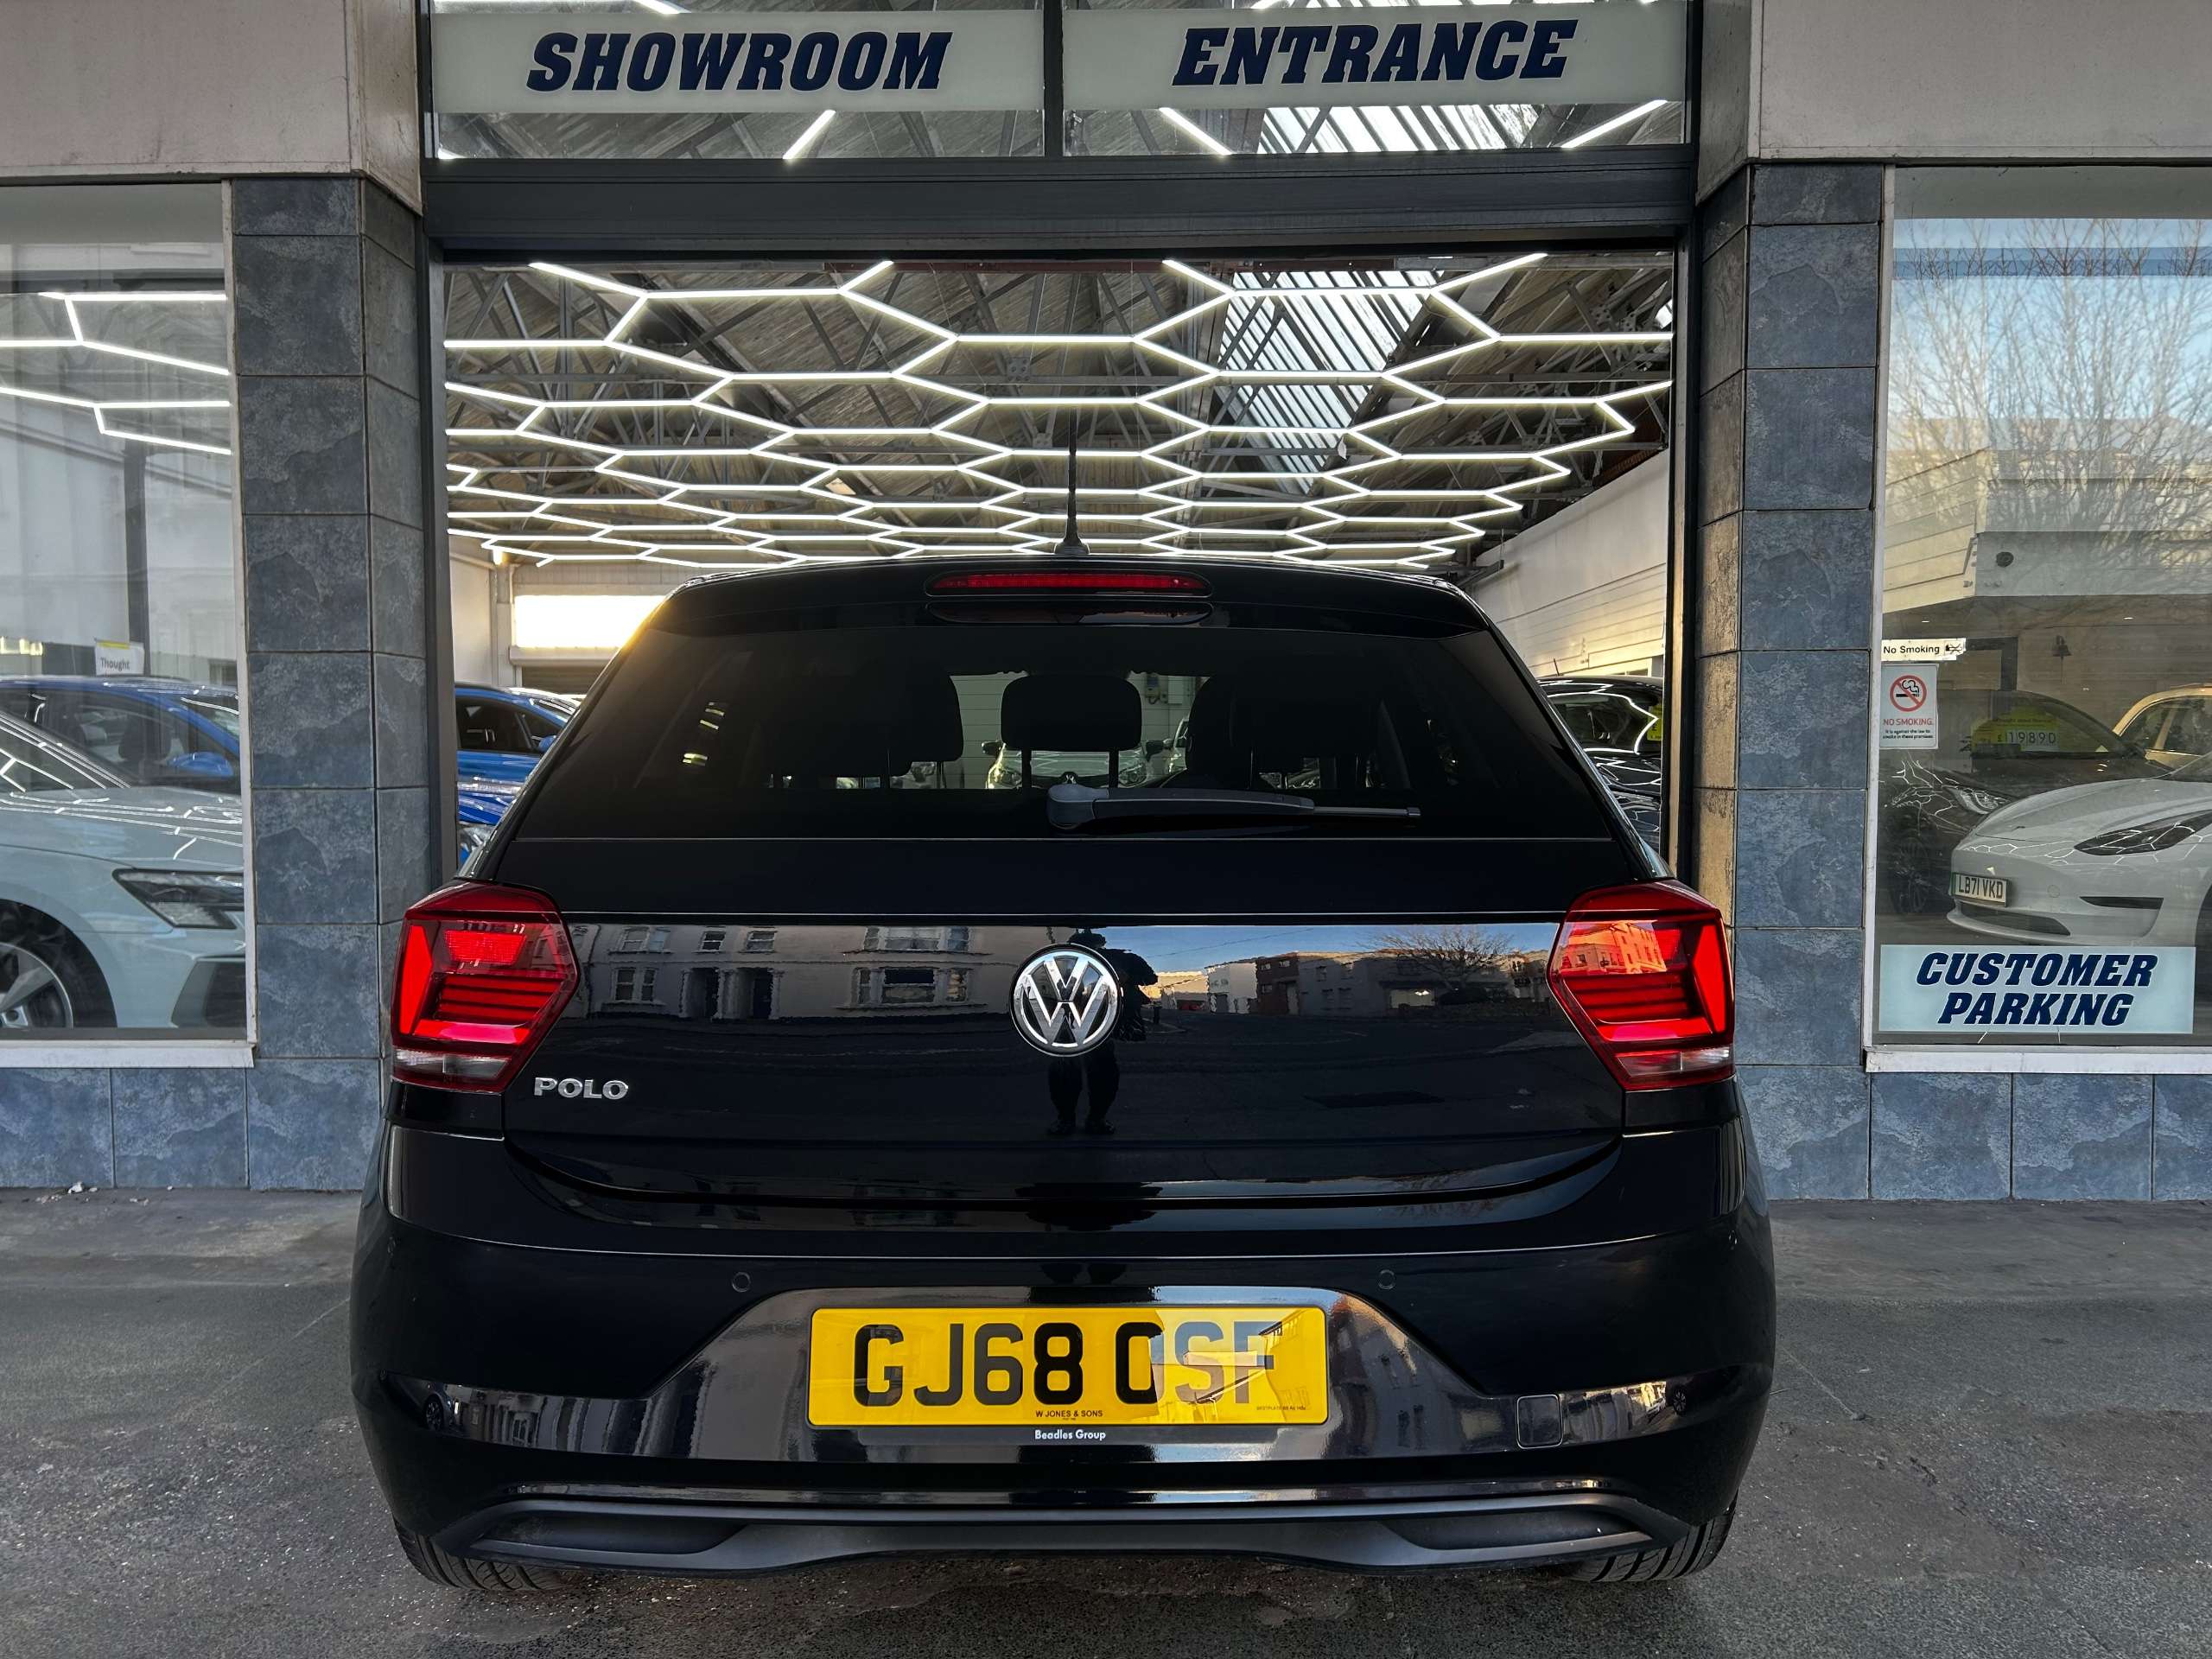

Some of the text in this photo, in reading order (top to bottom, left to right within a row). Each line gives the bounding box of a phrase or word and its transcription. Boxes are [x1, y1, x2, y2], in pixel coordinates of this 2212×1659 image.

[525, 19, 1579, 92] SHOWROOM ENTRANCE
[1899, 645, 1940, 654] Smoking
[100, 657, 130, 671] Thought
[1959, 876, 2004, 899] LB71 VKD
[1916, 952, 2158, 987] CUSTOMER
[1937, 992, 2134, 1026] PARKING
[534, 1077, 629, 1100] POLO
[854, 1321, 1283, 1407] GJ68 OSF
[1034, 1429, 1106, 1441] Beadles Group
